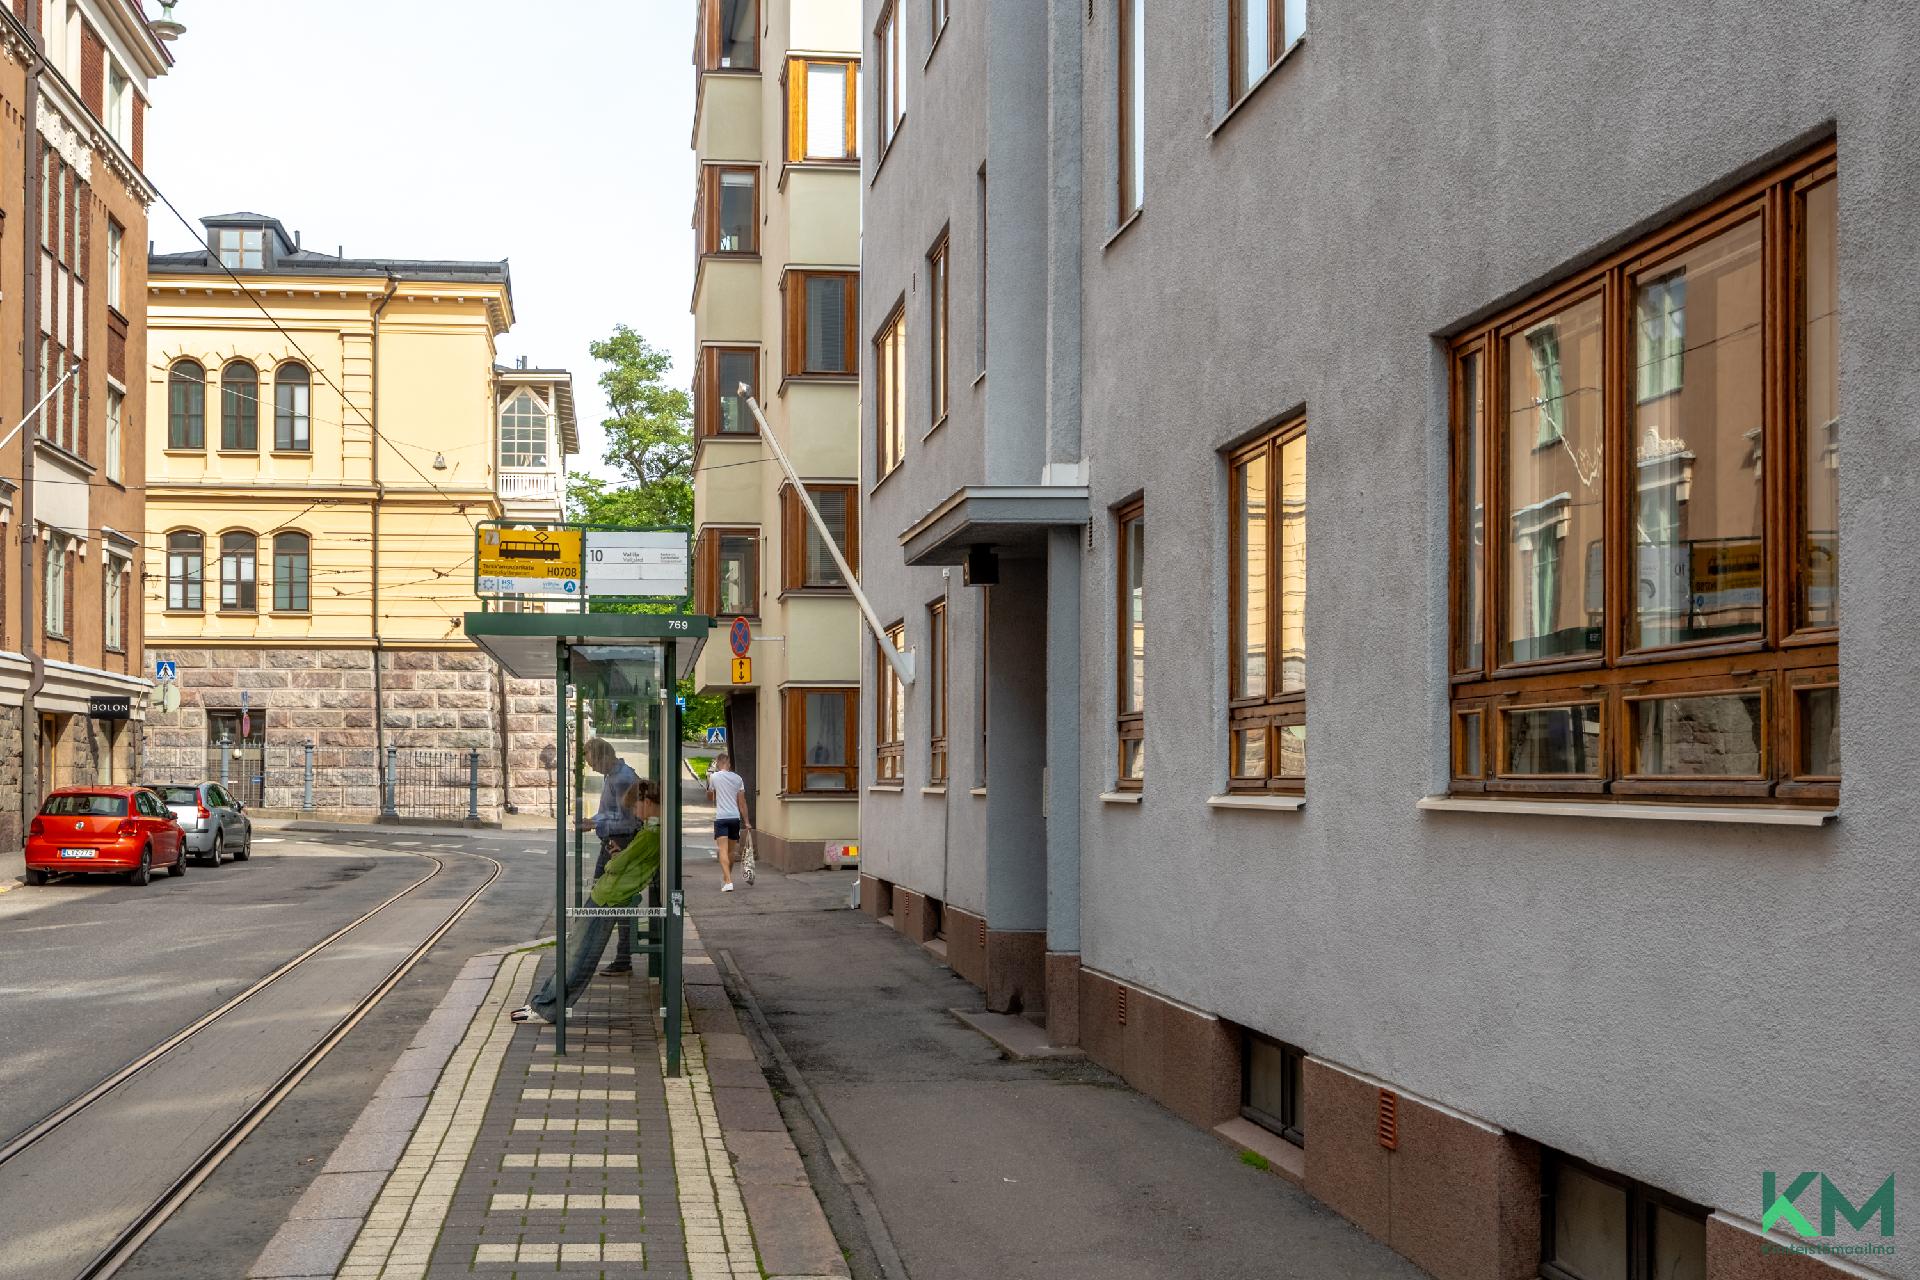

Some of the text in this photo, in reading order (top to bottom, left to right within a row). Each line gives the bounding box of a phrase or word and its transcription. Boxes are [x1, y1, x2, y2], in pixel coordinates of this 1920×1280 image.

[590, 549, 603, 562] 10
[547, 567, 577, 577] H0708
[668, 620, 688, 630] 769
[91, 704, 128, 712] BOLON
